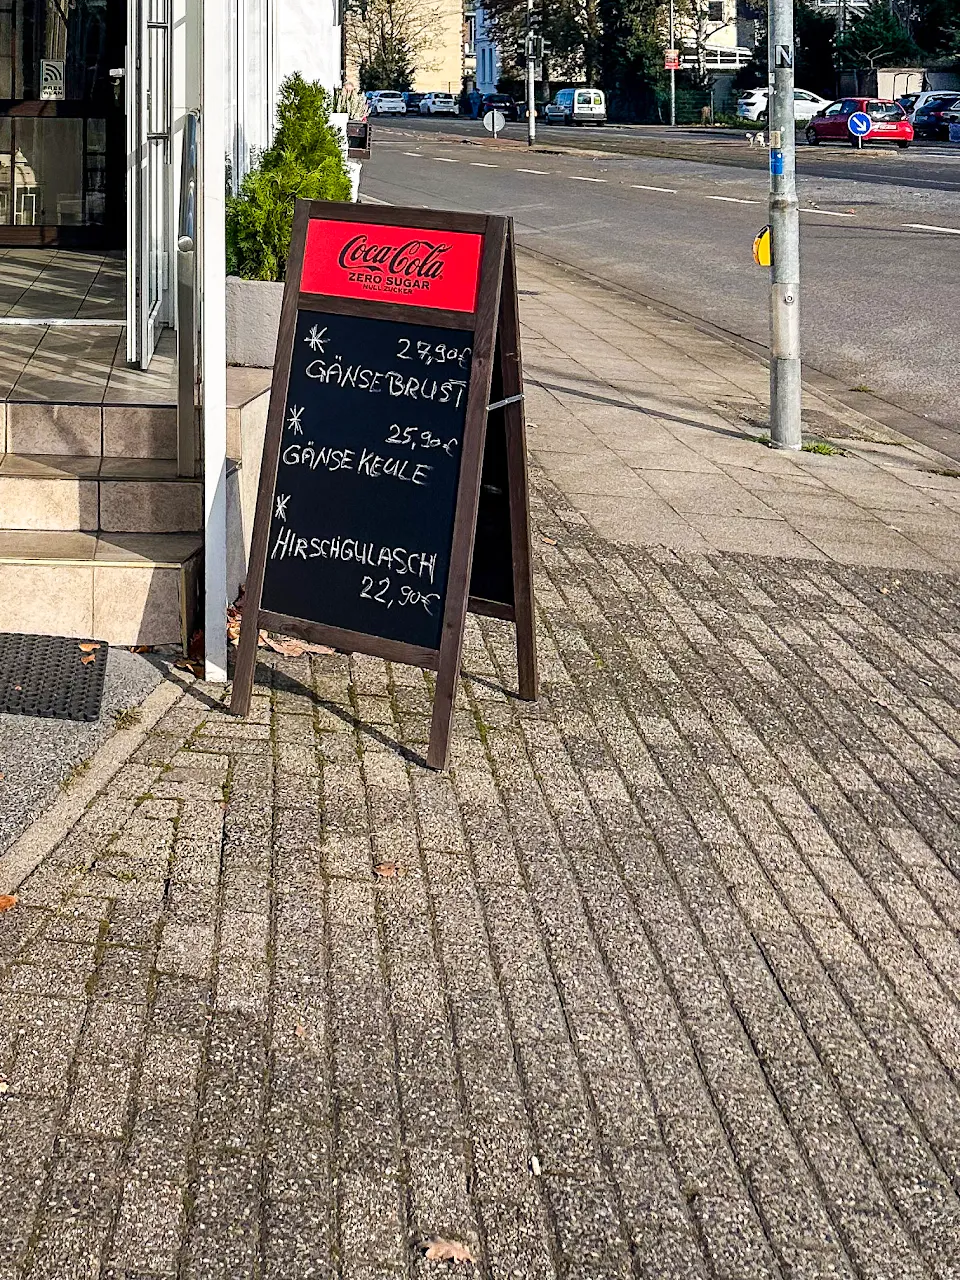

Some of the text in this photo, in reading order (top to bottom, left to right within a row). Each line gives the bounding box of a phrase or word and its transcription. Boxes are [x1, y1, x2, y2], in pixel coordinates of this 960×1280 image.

[339, 234, 452, 279] Coca-Cola
[348, 272, 430, 290] ZERO SUGAR
[362, 283, 413, 295] NULL ZUCKER
[305, 355, 468, 409] GÄNSEBRUST
